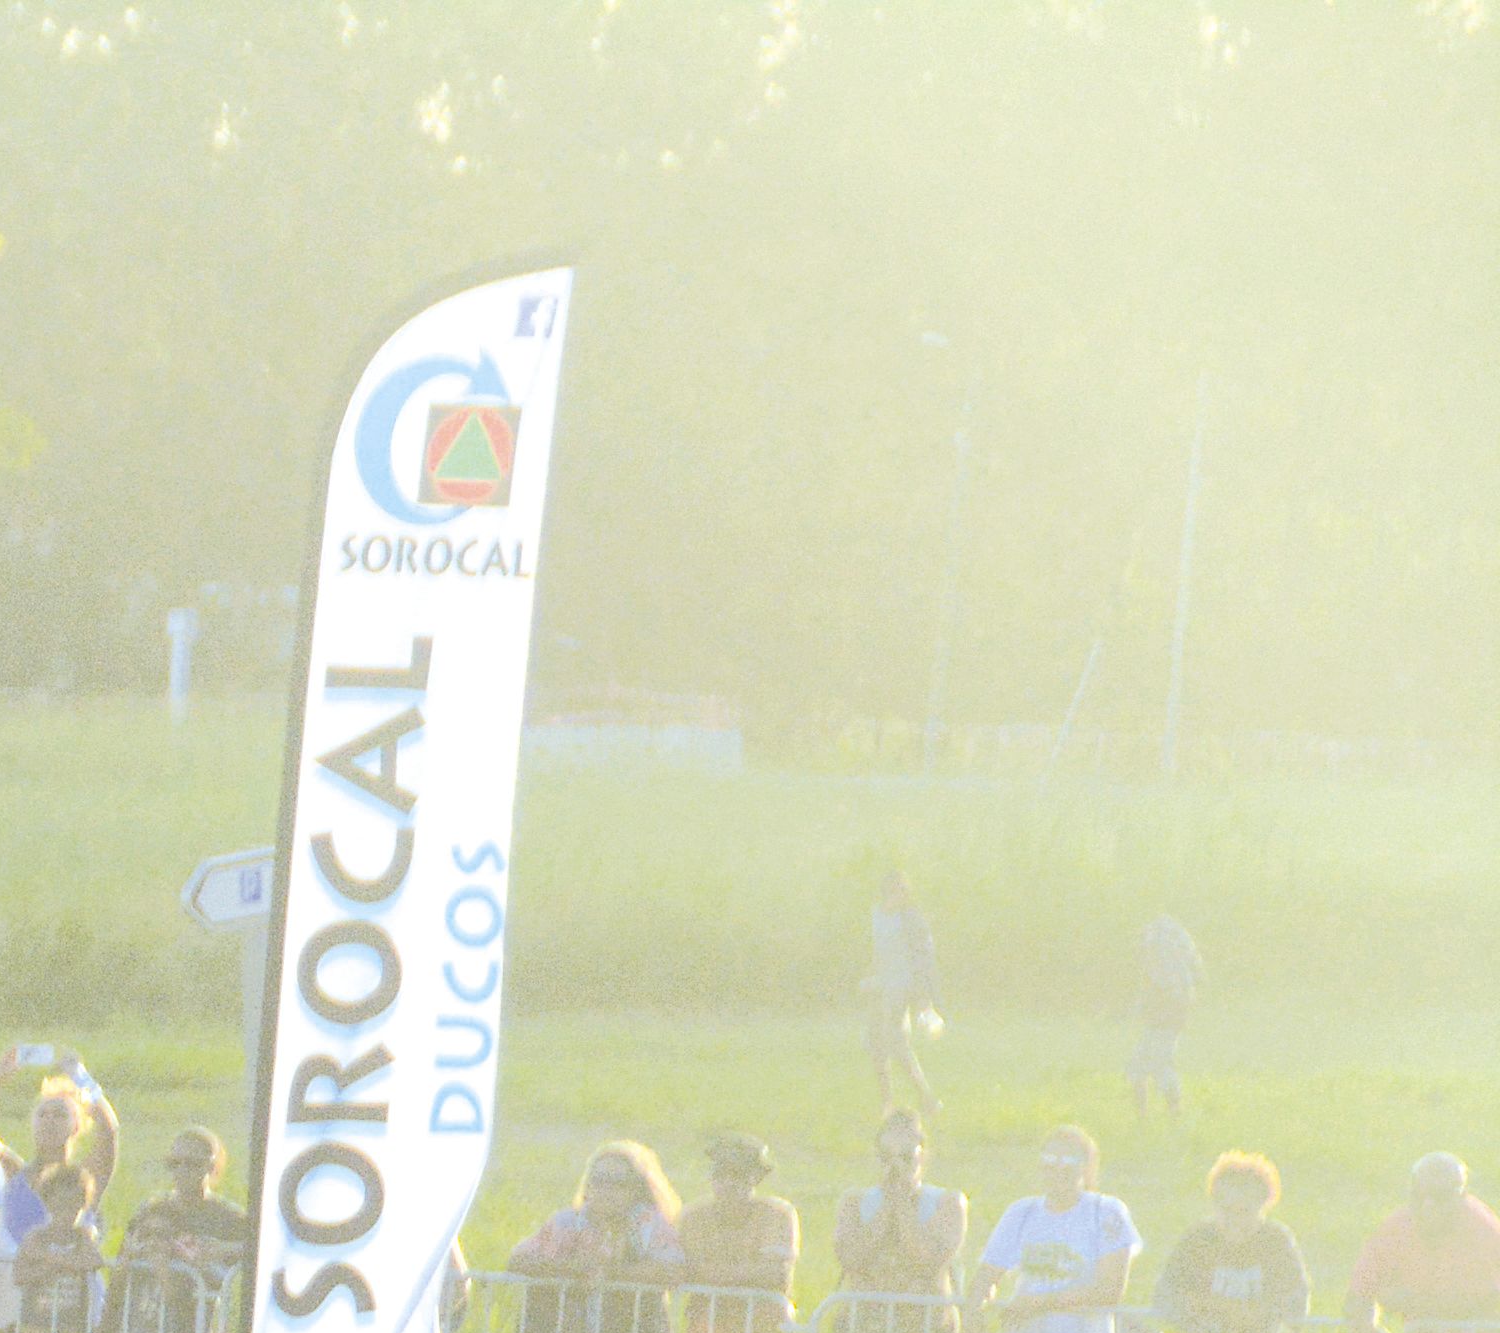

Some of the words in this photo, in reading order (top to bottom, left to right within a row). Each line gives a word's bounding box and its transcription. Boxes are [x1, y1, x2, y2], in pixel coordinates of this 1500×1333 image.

[341, 533, 531, 579] SOROCAL
[272, 636, 434, 1319] SOROCAL
[429, 838, 506, 1134] DUCOS
